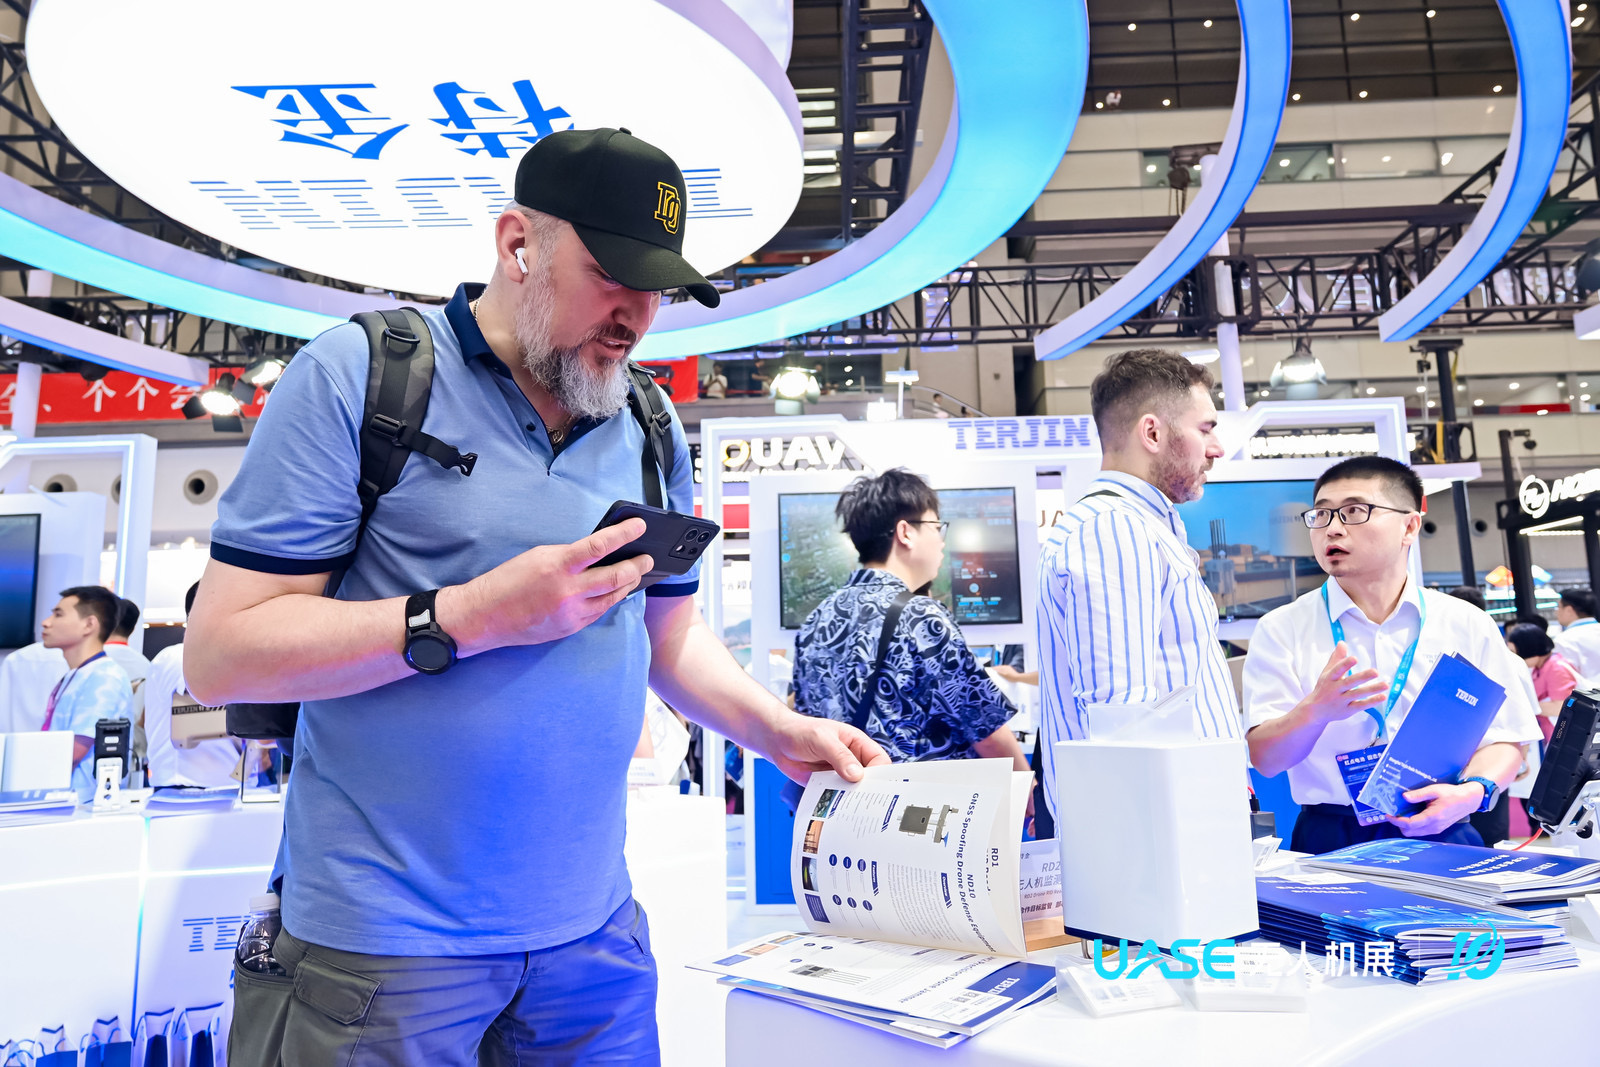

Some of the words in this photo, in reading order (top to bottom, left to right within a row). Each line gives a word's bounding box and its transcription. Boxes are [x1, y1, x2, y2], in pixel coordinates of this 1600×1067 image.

[230, 79, 574, 160] 特金
[189, 168, 753, 230] TJIN
[947, 418, 1091, 450] TERJIN
[1455, 688, 1479, 707] TERJIN
[966, 792, 979, 816] GNSS
[956, 817, 971, 859] Spoofing
[991, 847, 999, 868] RD1
[956, 859, 964, 890] Drone
[967, 873, 976, 899] ND10
[959, 891, 974, 923] Defense
[182, 915, 251, 952] TE
